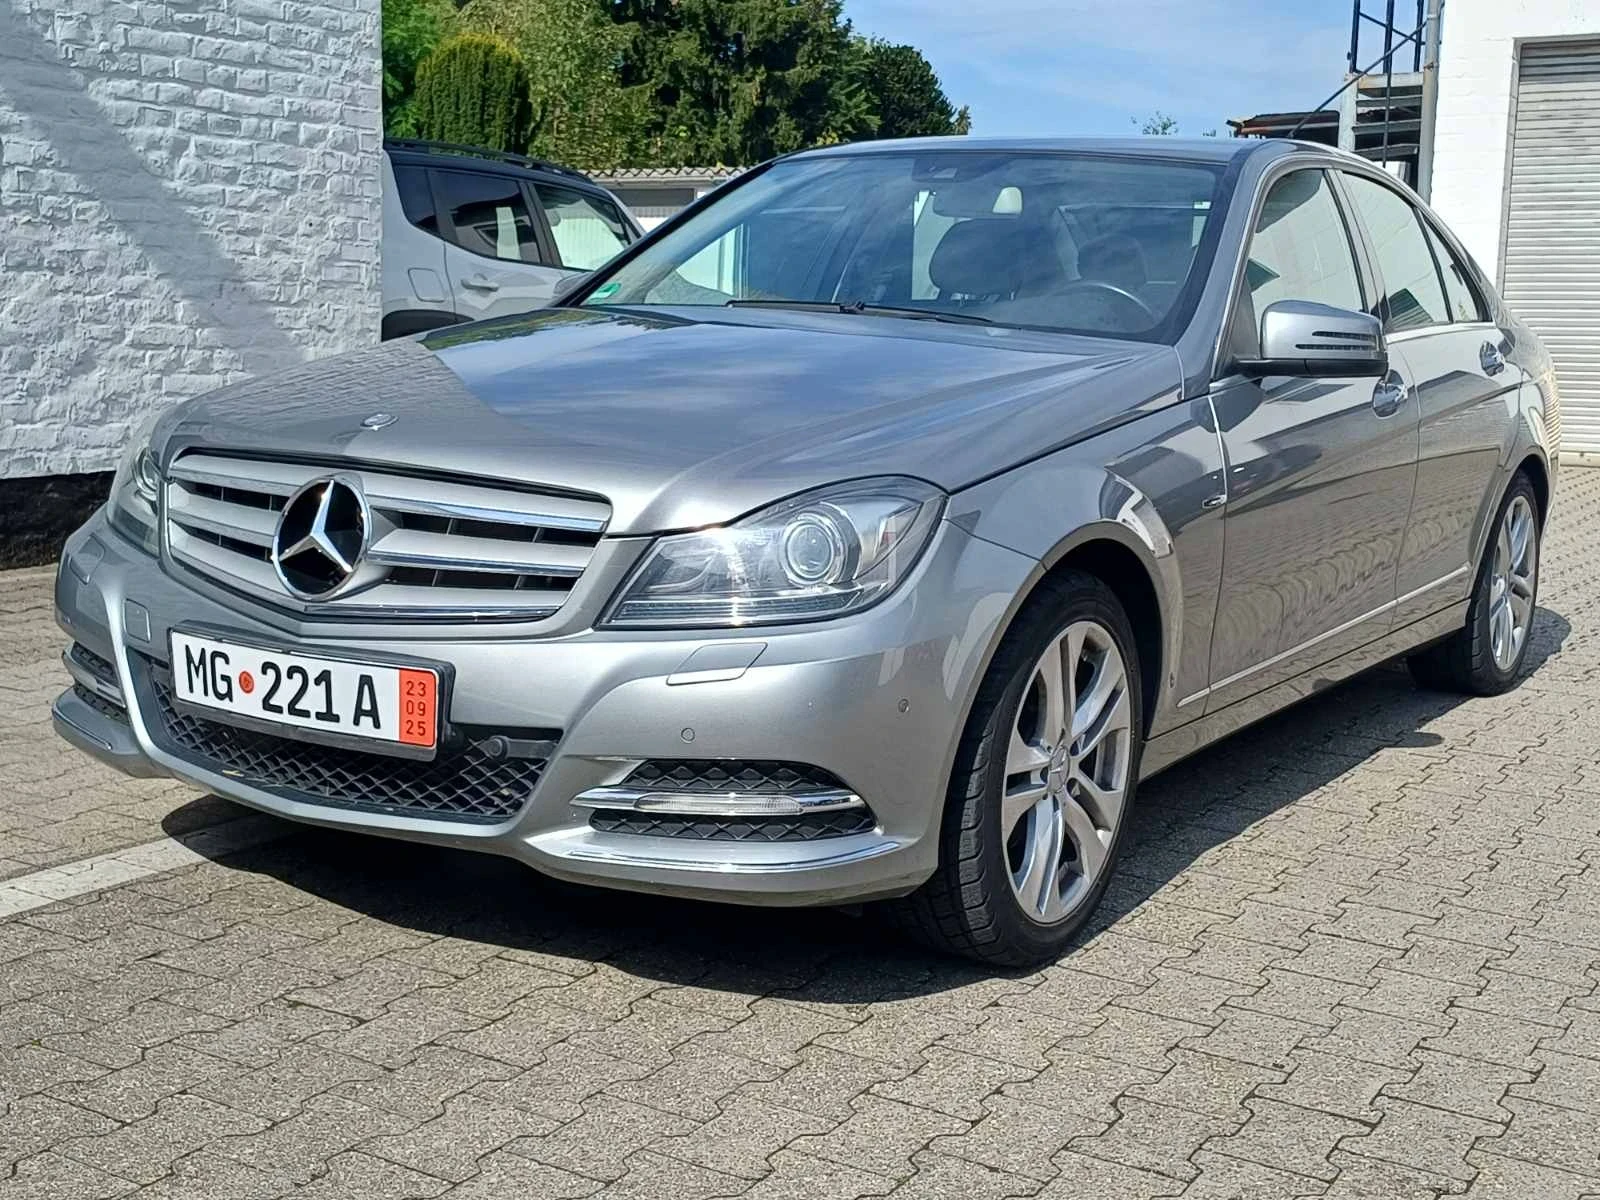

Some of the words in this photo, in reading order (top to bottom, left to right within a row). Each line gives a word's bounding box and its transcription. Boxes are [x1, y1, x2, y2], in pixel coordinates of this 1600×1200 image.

[185, 644, 233, 702] MG
[261, 661, 340, 723] 221
[353, 674, 381, 729] A
[406, 680, 426, 697] 23
[406, 699, 426, 716] 09
[406, 719, 426, 736] 25
